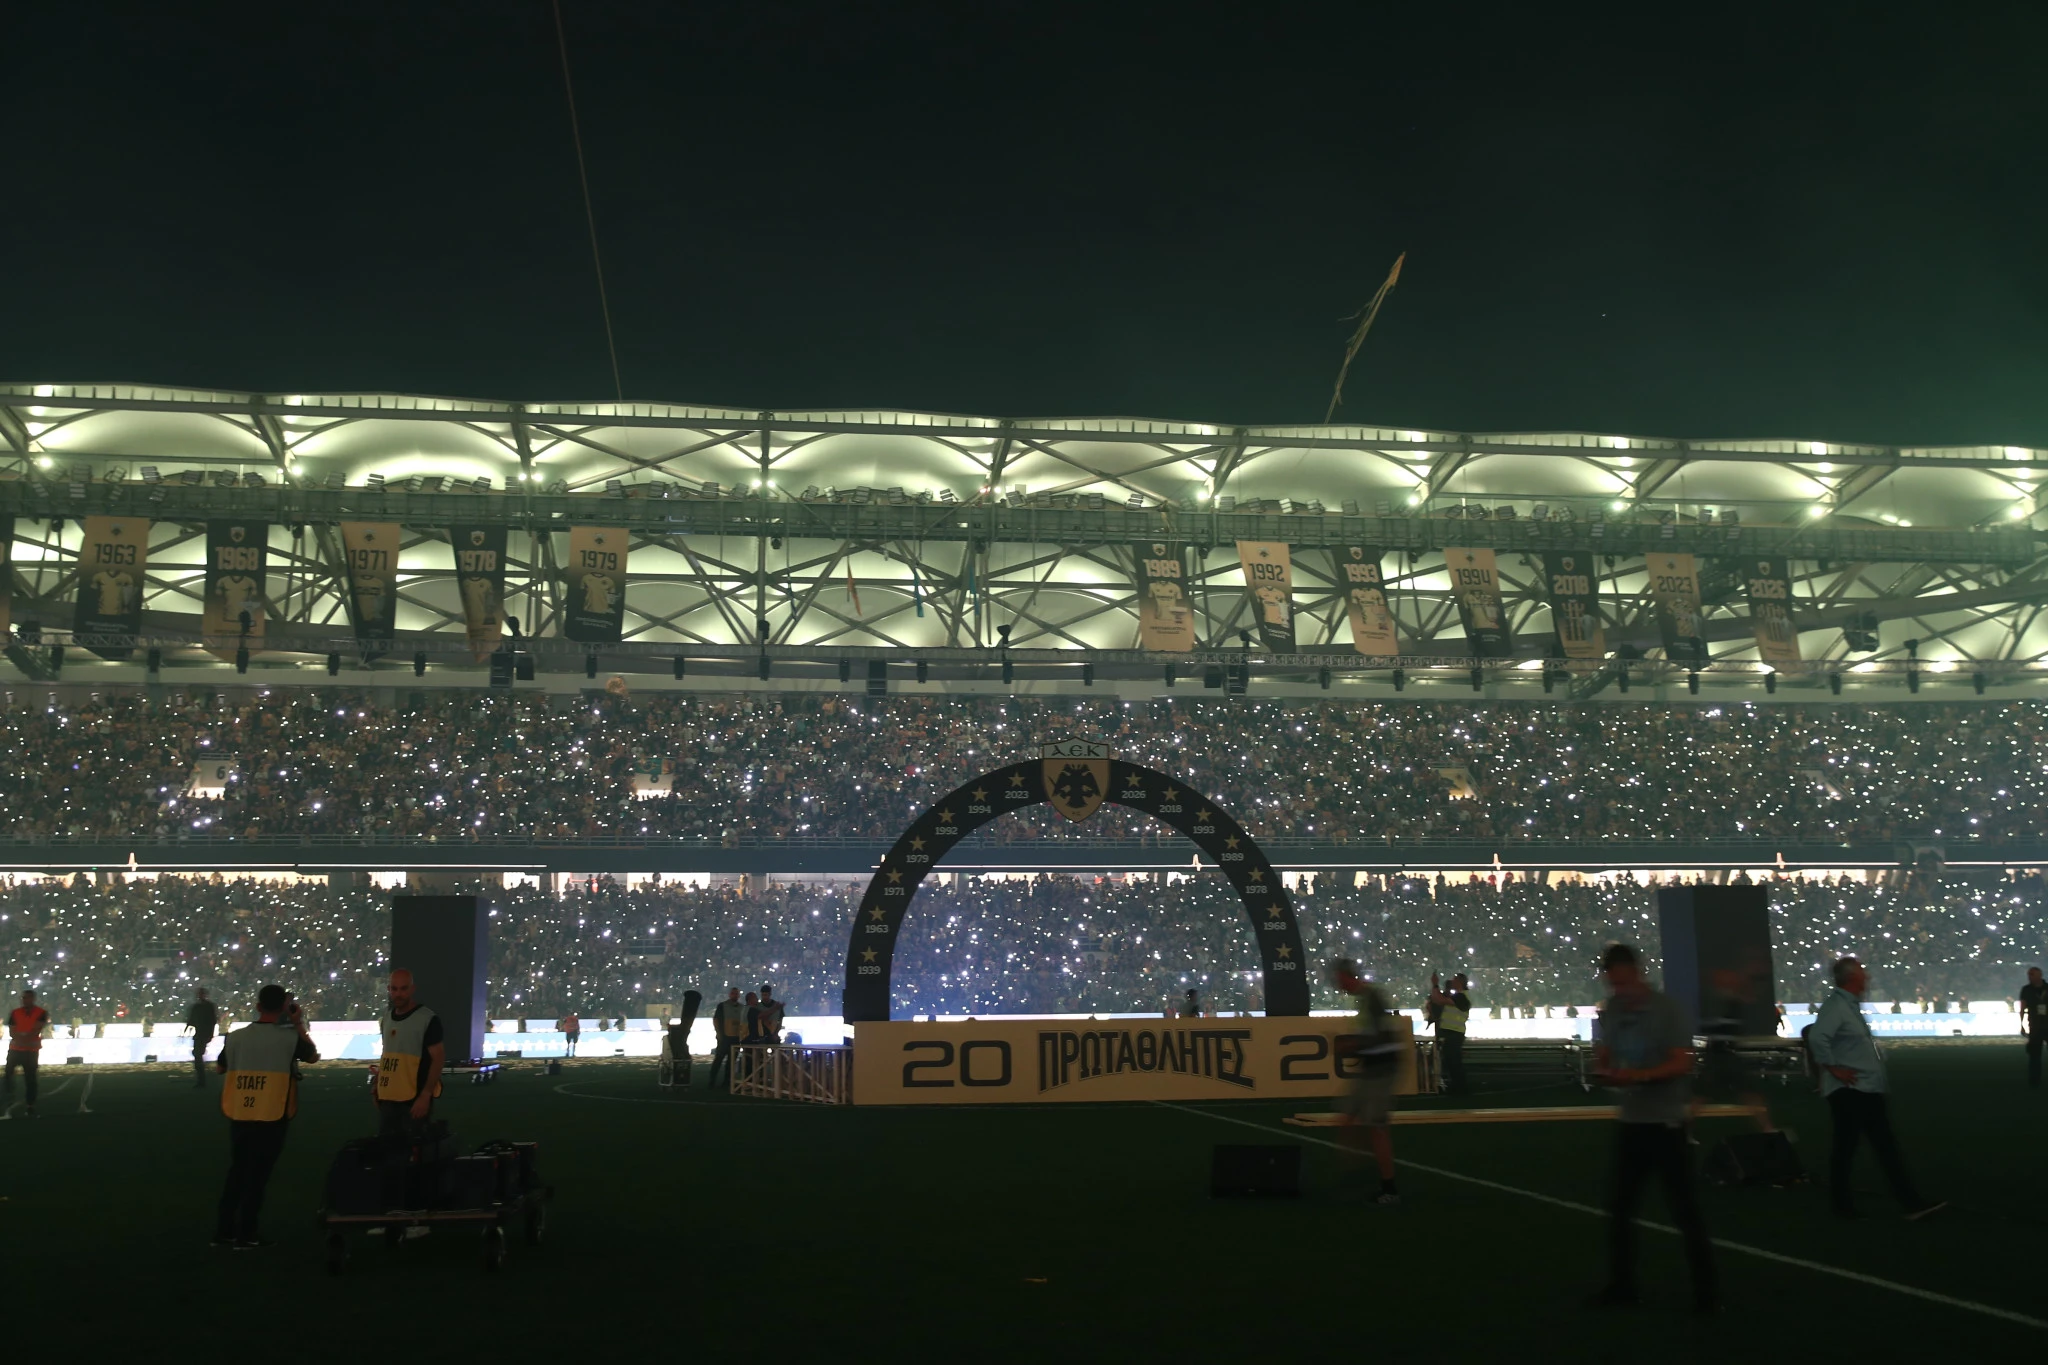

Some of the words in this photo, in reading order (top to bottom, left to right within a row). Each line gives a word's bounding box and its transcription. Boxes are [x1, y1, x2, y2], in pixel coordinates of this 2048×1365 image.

[94, 543, 137, 566] 1963
[215, 546, 259, 571] 1968
[350, 549, 388, 571] 1971
[457, 550, 498, 572] 1978
[579, 549, 618, 571] 1979
[1142, 558, 1182, 579] 1989
[1248, 563, 1284, 582] 1992
[1343, 563, 1380, 583] 1993
[1455, 568, 1491, 587] 1994
[1552, 574, 1591, 596] 2018
[1657, 575, 1693, 594] 2023
[216, 766, 226, 780] 6
[1004, 790, 1029, 800] 2023
[1121, 790, 1146, 800] 2026
[967, 805, 992, 815] 1994
[1159, 804, 1183, 814] 2018
[934, 826, 958, 836] 1992
[1192, 825, 1216, 835] 1993
[905, 854, 930, 864] 1979
[1220, 853, 1245, 862] 1989
[883, 887, 905, 897] 1971
[1245, 885, 1268, 895] 1978
[864, 924, 889, 934] 1963
[1263, 921, 1287, 931] 1968
[857, 965, 881, 975] 1939
[1271, 962, 1296, 972] 1940
[382, 1057, 400, 1073] TAFF
[902, 1040, 1012, 1088] 20
[1039, 1030, 1256, 1092] ΠΡΩΤΑΘΛΗΤΕΣ
[236, 1075, 267, 1091] STAFF
[243, 1096, 255, 1108] 32
